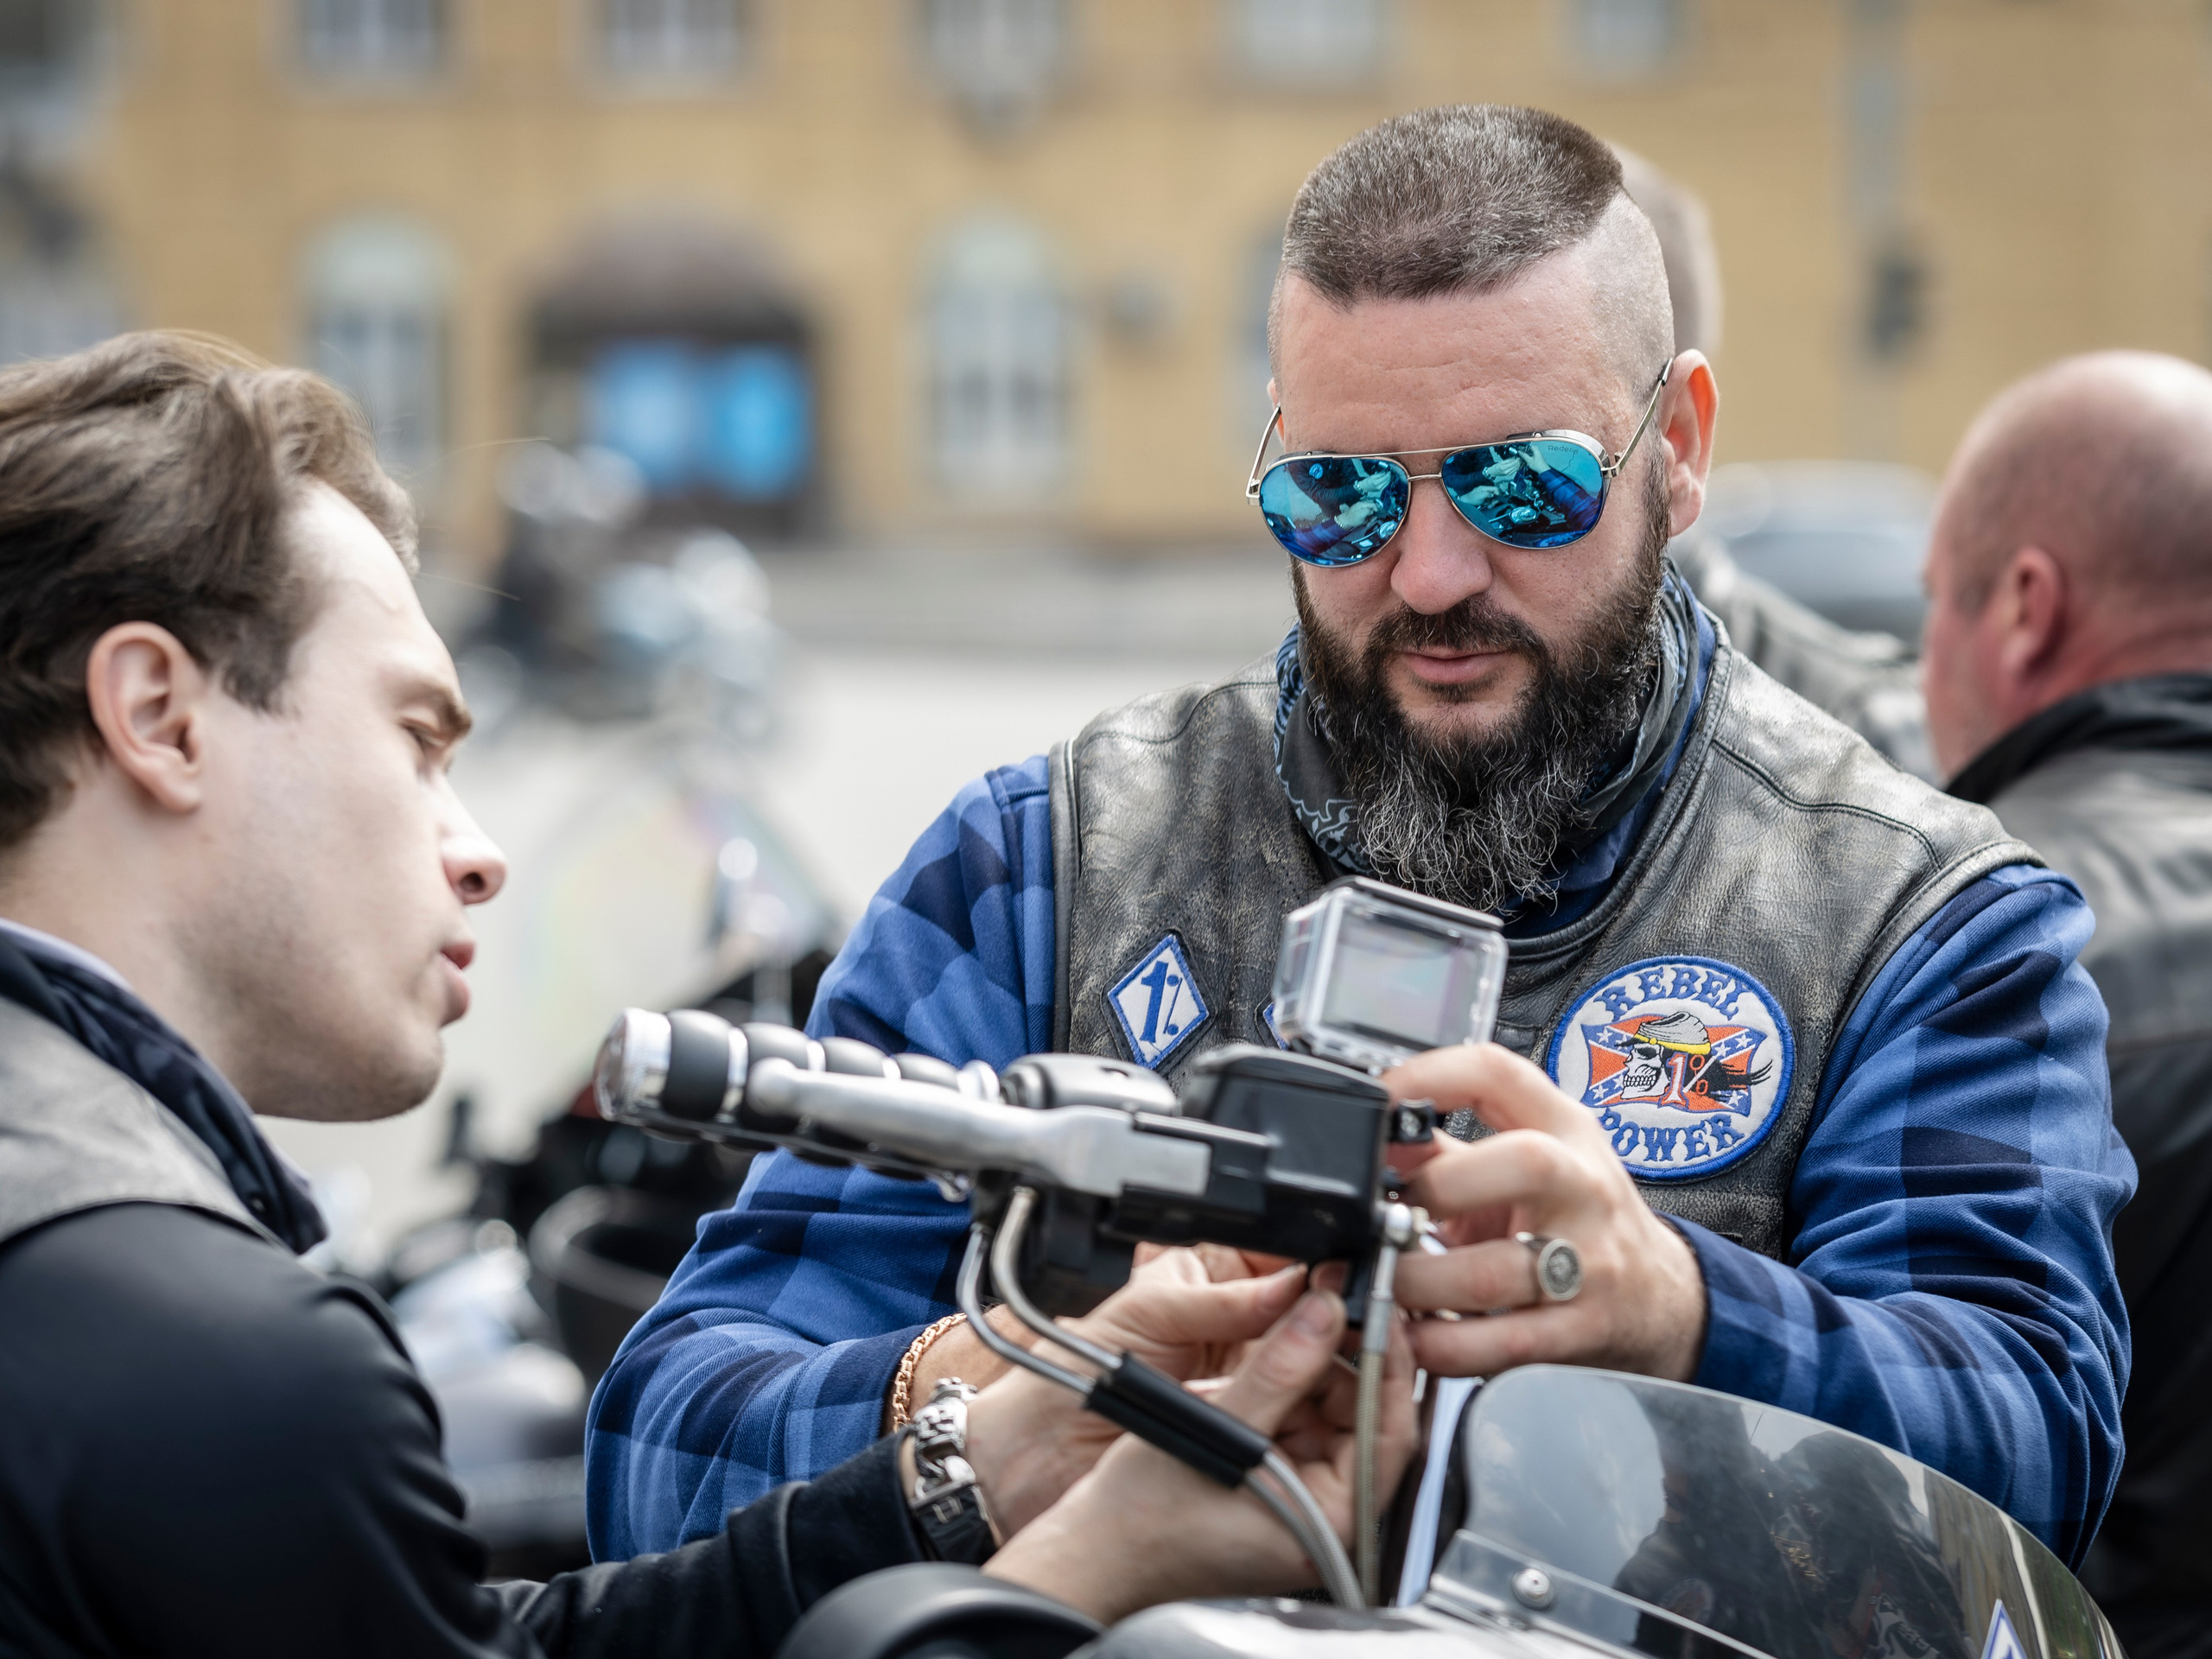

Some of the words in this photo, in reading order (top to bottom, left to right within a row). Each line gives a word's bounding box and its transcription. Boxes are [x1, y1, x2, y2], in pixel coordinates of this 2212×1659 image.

[1141, 962, 1183, 1043] 1%
[1593, 966, 1754, 1020] REBEL
[1598, 1108, 1745, 1161] POWER
